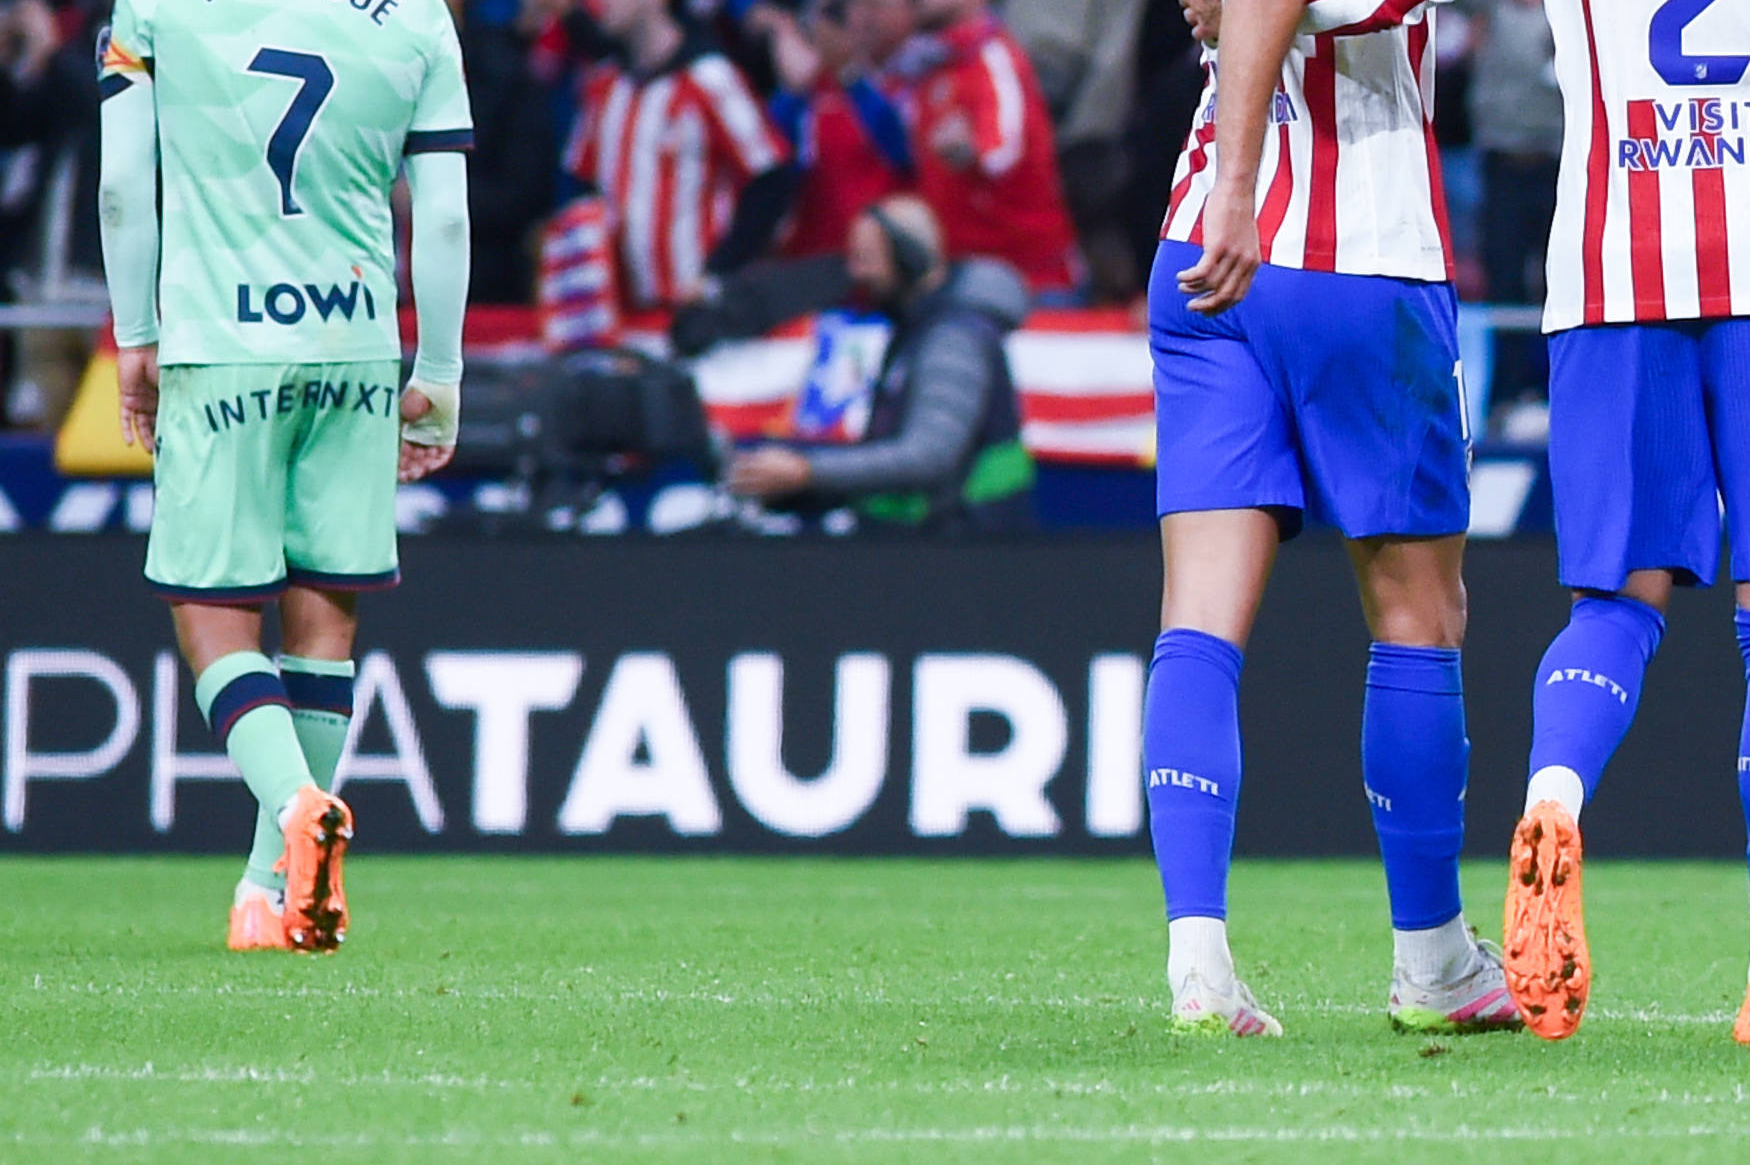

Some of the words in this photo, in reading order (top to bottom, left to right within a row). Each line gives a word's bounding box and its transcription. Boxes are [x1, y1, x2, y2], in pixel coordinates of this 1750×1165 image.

[247, 47, 335, 215] 7
[1547, 668, 1628, 704] ATLETI
[1149, 767, 1219, 797] ATLETI
